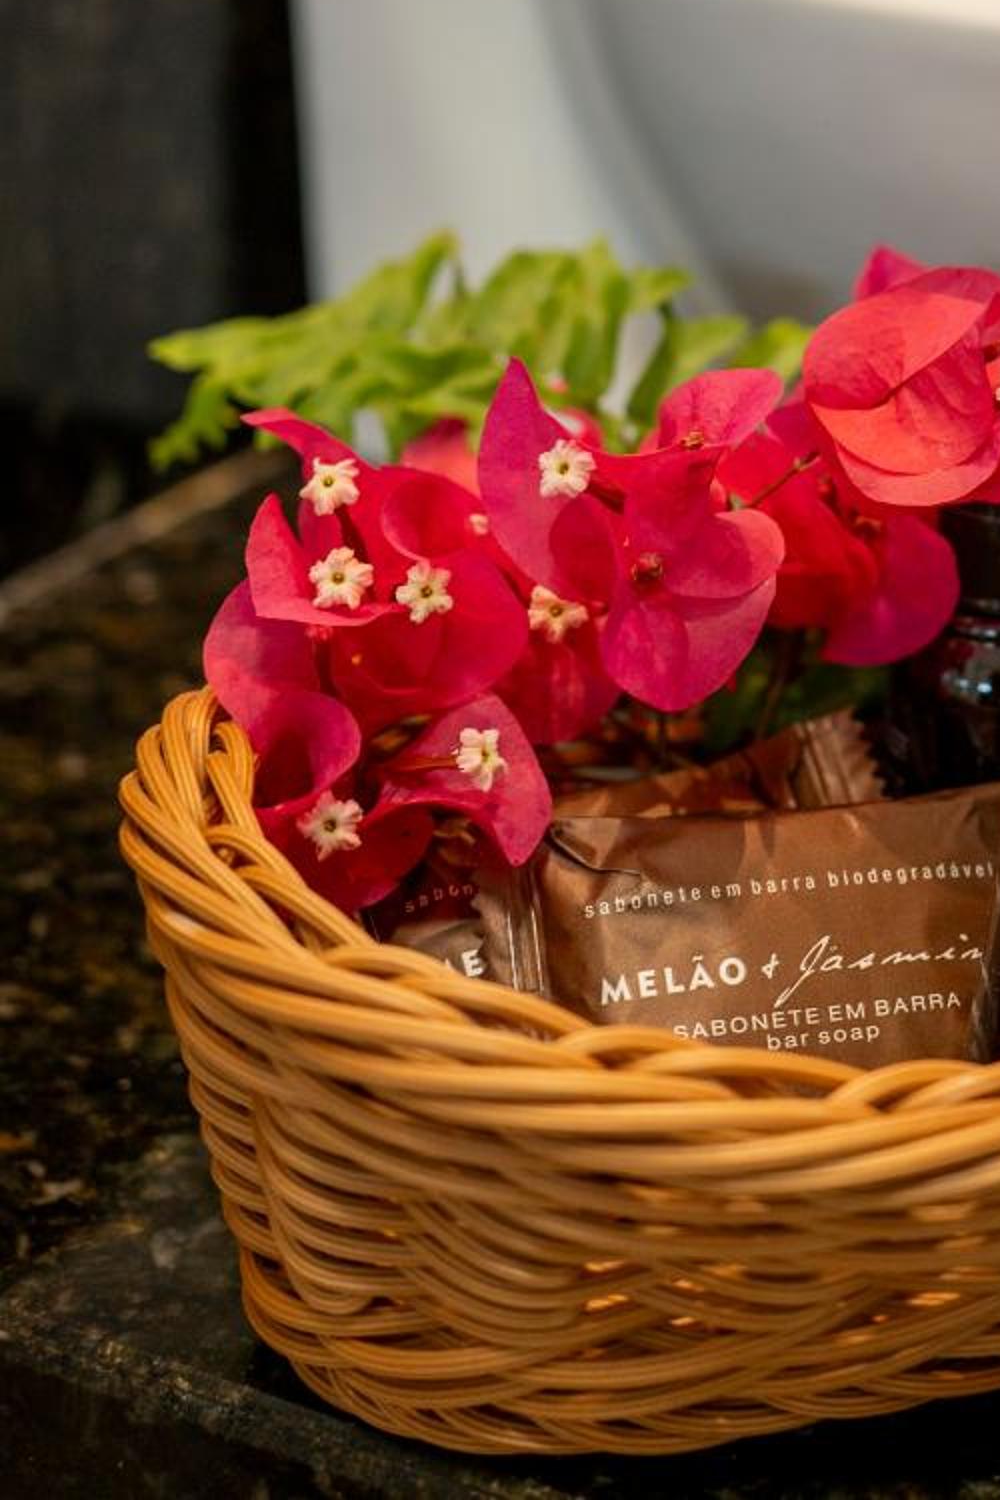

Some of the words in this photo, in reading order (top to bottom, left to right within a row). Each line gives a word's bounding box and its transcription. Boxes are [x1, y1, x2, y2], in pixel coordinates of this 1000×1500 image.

[584, 886, 701, 918] sabonete
[711, 883, 741, 898] em
[752, 876, 816, 895] barra
[827, 862, 994, 888] biodegradável
[601, 953, 747, 1005] MELÃO
[673, 1007, 820, 1040] SABONETE
[829, 1001, 865, 1022] EM
[874, 992, 961, 1018] BARRA
[766, 1031, 810, 1050] bar
[818, 1025, 880, 1045] soap
